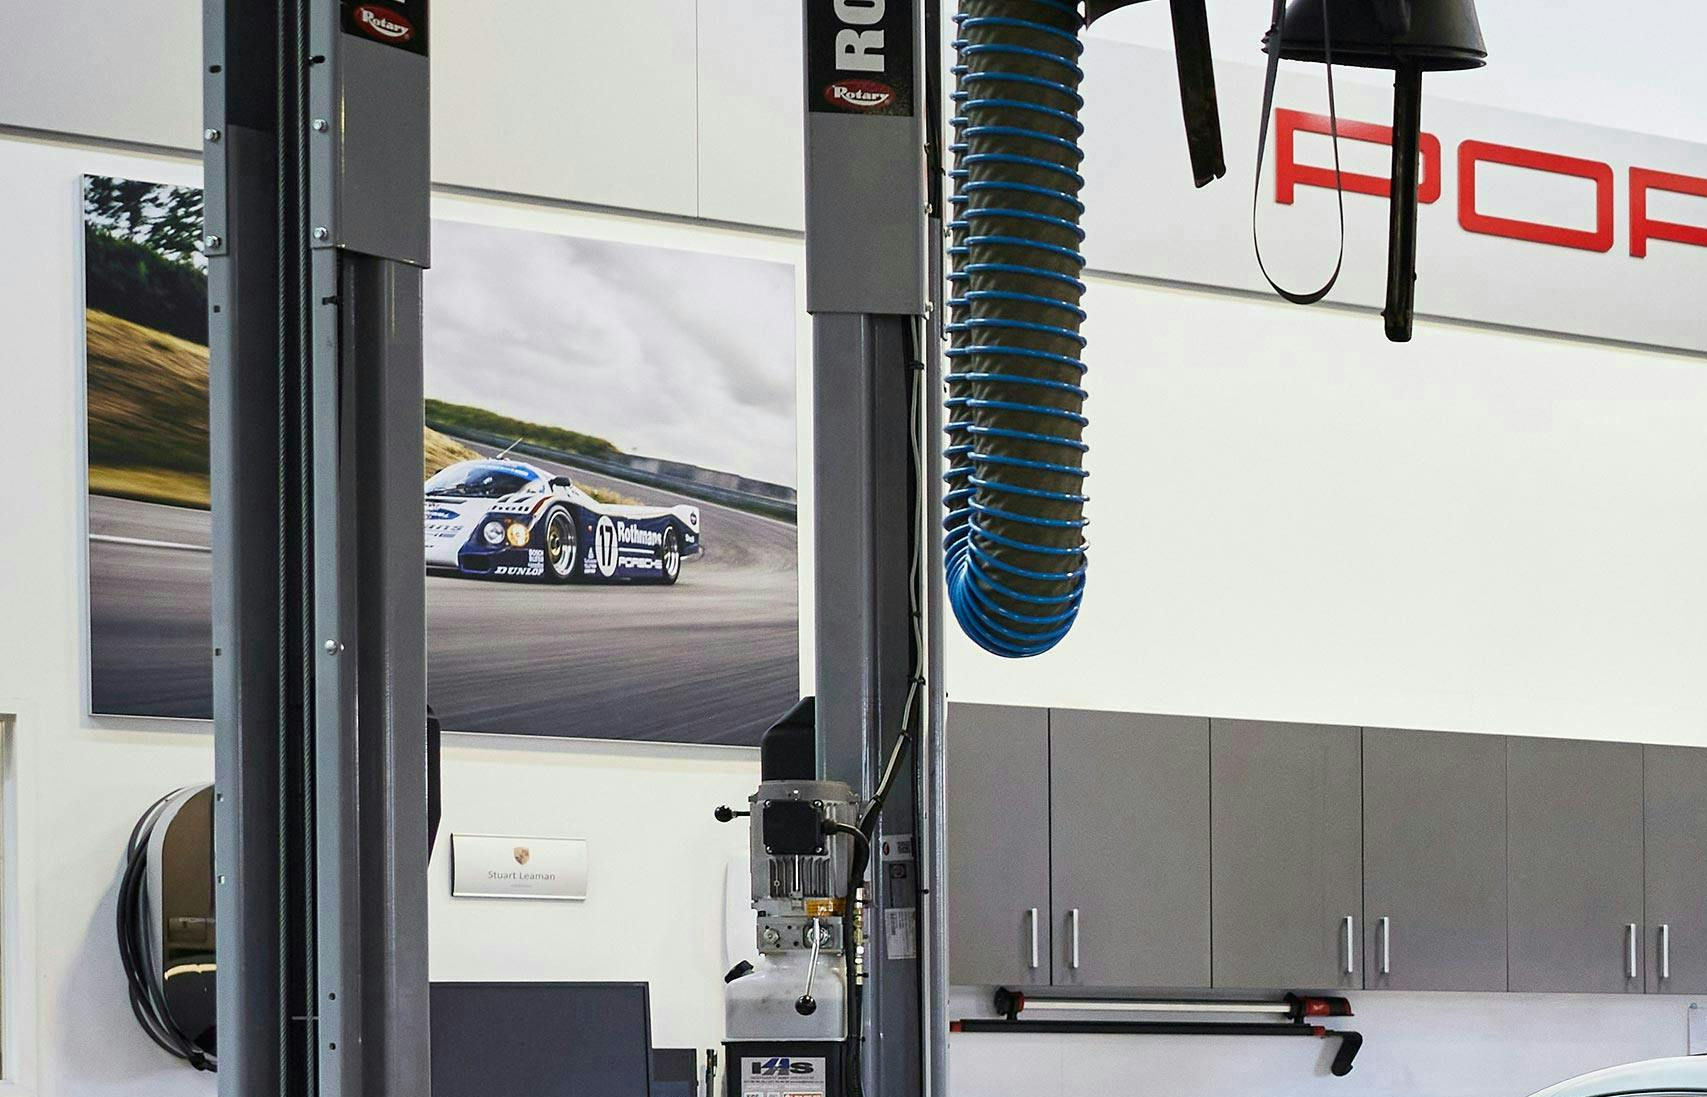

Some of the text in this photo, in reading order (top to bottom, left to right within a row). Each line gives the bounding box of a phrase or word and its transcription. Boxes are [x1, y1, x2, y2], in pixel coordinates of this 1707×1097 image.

[360, 7, 409, 37] Rotary
[832, 84, 890, 106] Rotary
[600, 524, 613, 567] 17
[495, 566, 544, 576] DUNLOP
[487, 870, 556, 881] Stuart Leaman
